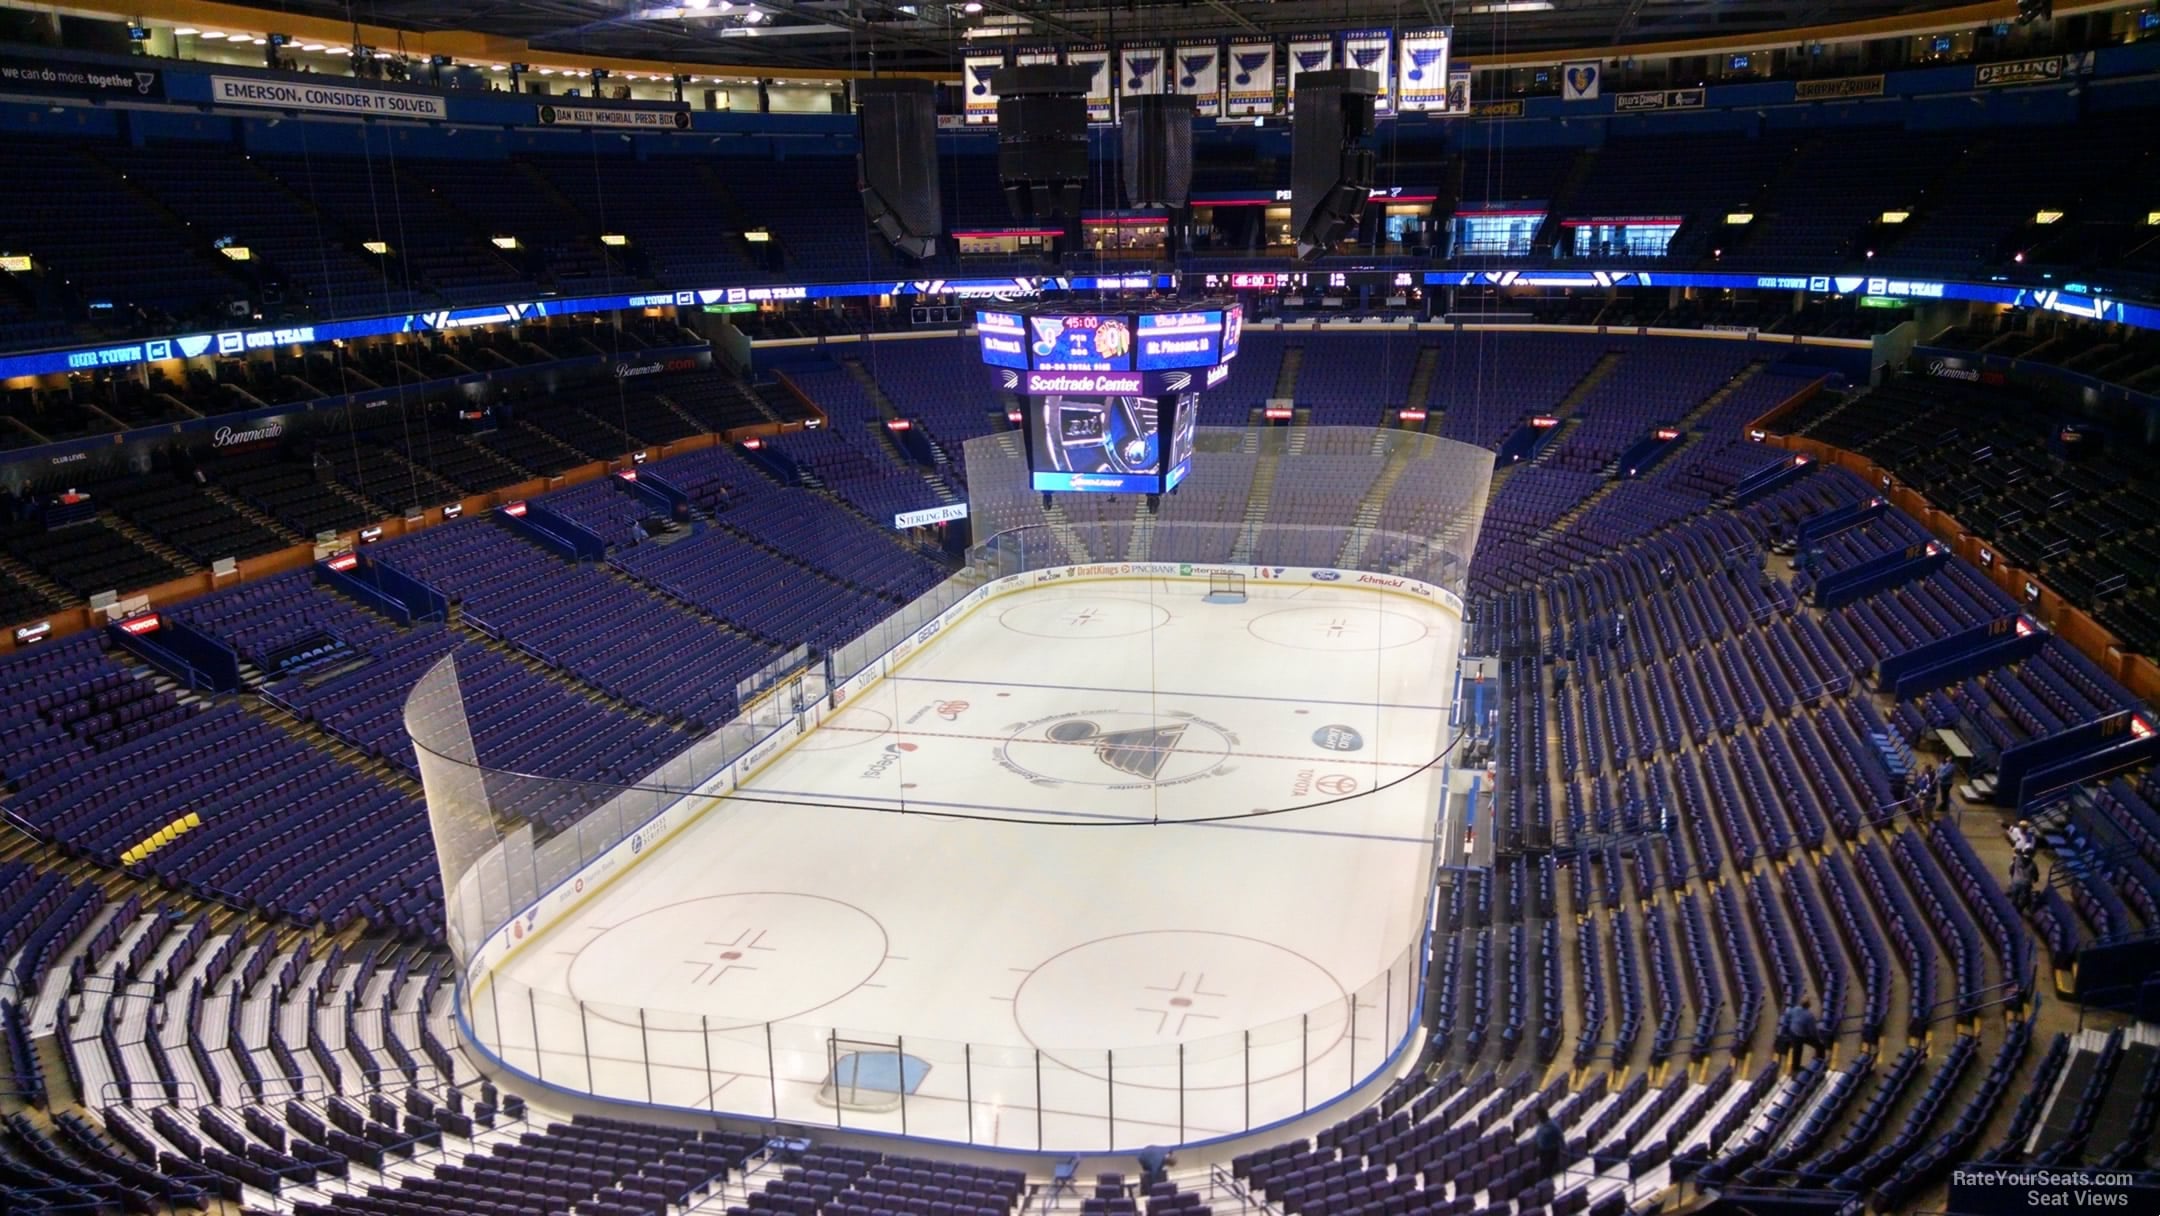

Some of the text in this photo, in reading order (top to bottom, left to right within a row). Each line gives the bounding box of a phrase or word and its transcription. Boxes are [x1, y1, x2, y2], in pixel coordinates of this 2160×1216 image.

[2, 67, 133, 88] we can do more. together
[1978, 60, 2058, 81] CEILING
[224, 84, 437, 113] EMERSON. CONSIDER IT SOLVED.
[557, 109, 674, 125] DAN KELLY MEMORIAL PRESS BOX
[1757, 277, 1807, 289] OUR TOWN
[1910, 283, 1945, 297] TEAM
[958, 290, 994, 299] BUD
[1066, 317, 1098, 328] 45:00
[246, 327, 315, 347] OUR TEAM
[68, 346, 142, 367] OUR TOWN
[614, 361, 664, 378] Bommarito
[1030, 375, 1140, 391] Scottrade Center
[212, 423, 282, 448] Bommarito
[52, 452, 87, 465] CLUB LEVEL
[898, 508, 963, 526] STERLING BANK
[1038, 574, 1060, 582] NHL.COM
[1077, 564, 1119, 576] DraftKings
[1358, 574, 1405, 588] Schnucks
[918, 620, 940, 644] GEICO
[858, 666, 878, 689] STIFEL
[1325, 727, 1354, 750] BUD LIGHT
[860, 753, 901, 779] pepsi
[1291, 768, 1315, 797] TOYOTA
